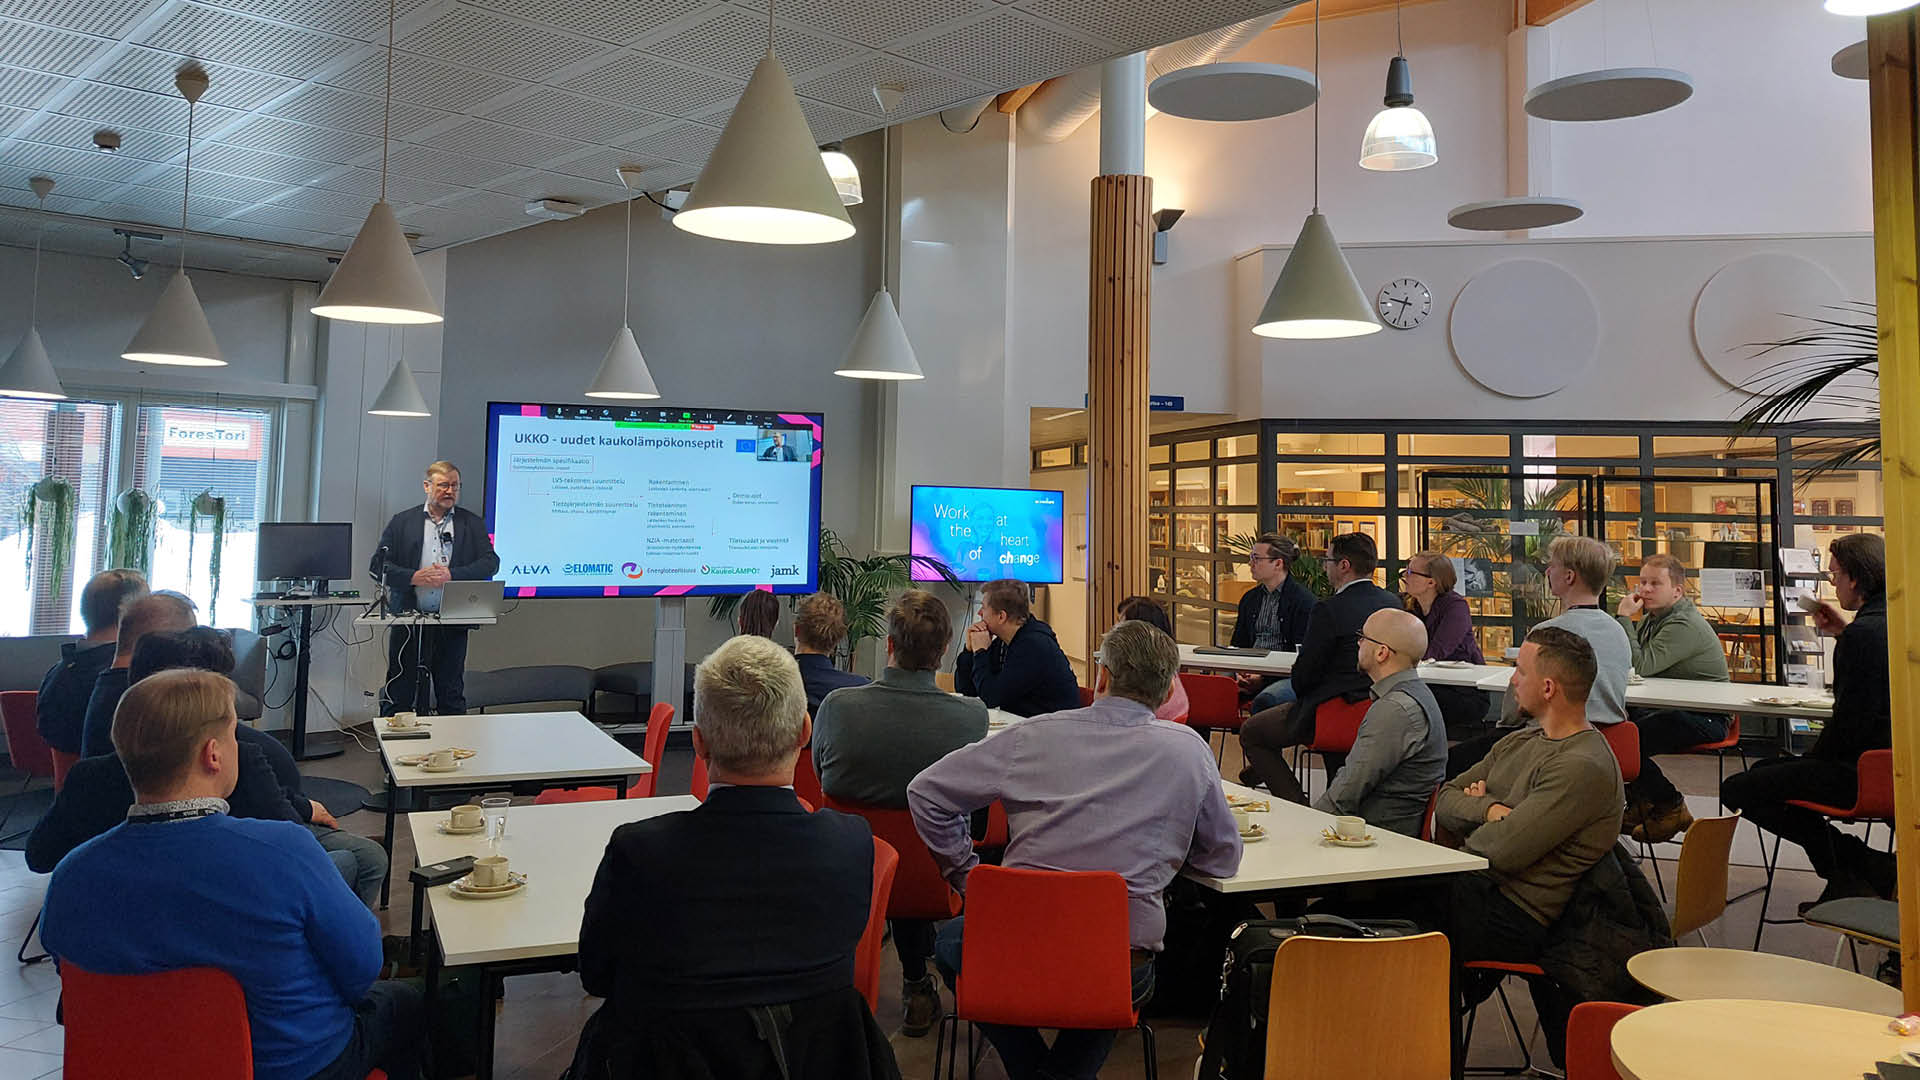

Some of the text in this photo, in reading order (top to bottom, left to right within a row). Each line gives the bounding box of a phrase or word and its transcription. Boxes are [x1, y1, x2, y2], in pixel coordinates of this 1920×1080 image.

[169, 427, 246, 441] ForesTori
[514, 433, 549, 444] UKKO
[560, 435, 596, 446] uudet
[599, 435, 724, 450] kaukolämpökonseptit
[933, 503, 1007, 527] Work at
[950, 523, 1029, 546] the heart
[969, 546, 1040, 566] of change
[511, 565, 551, 574] ALVA
[573, 563, 614, 573] ELOMATIC
[770, 564, 800, 578] jamk
